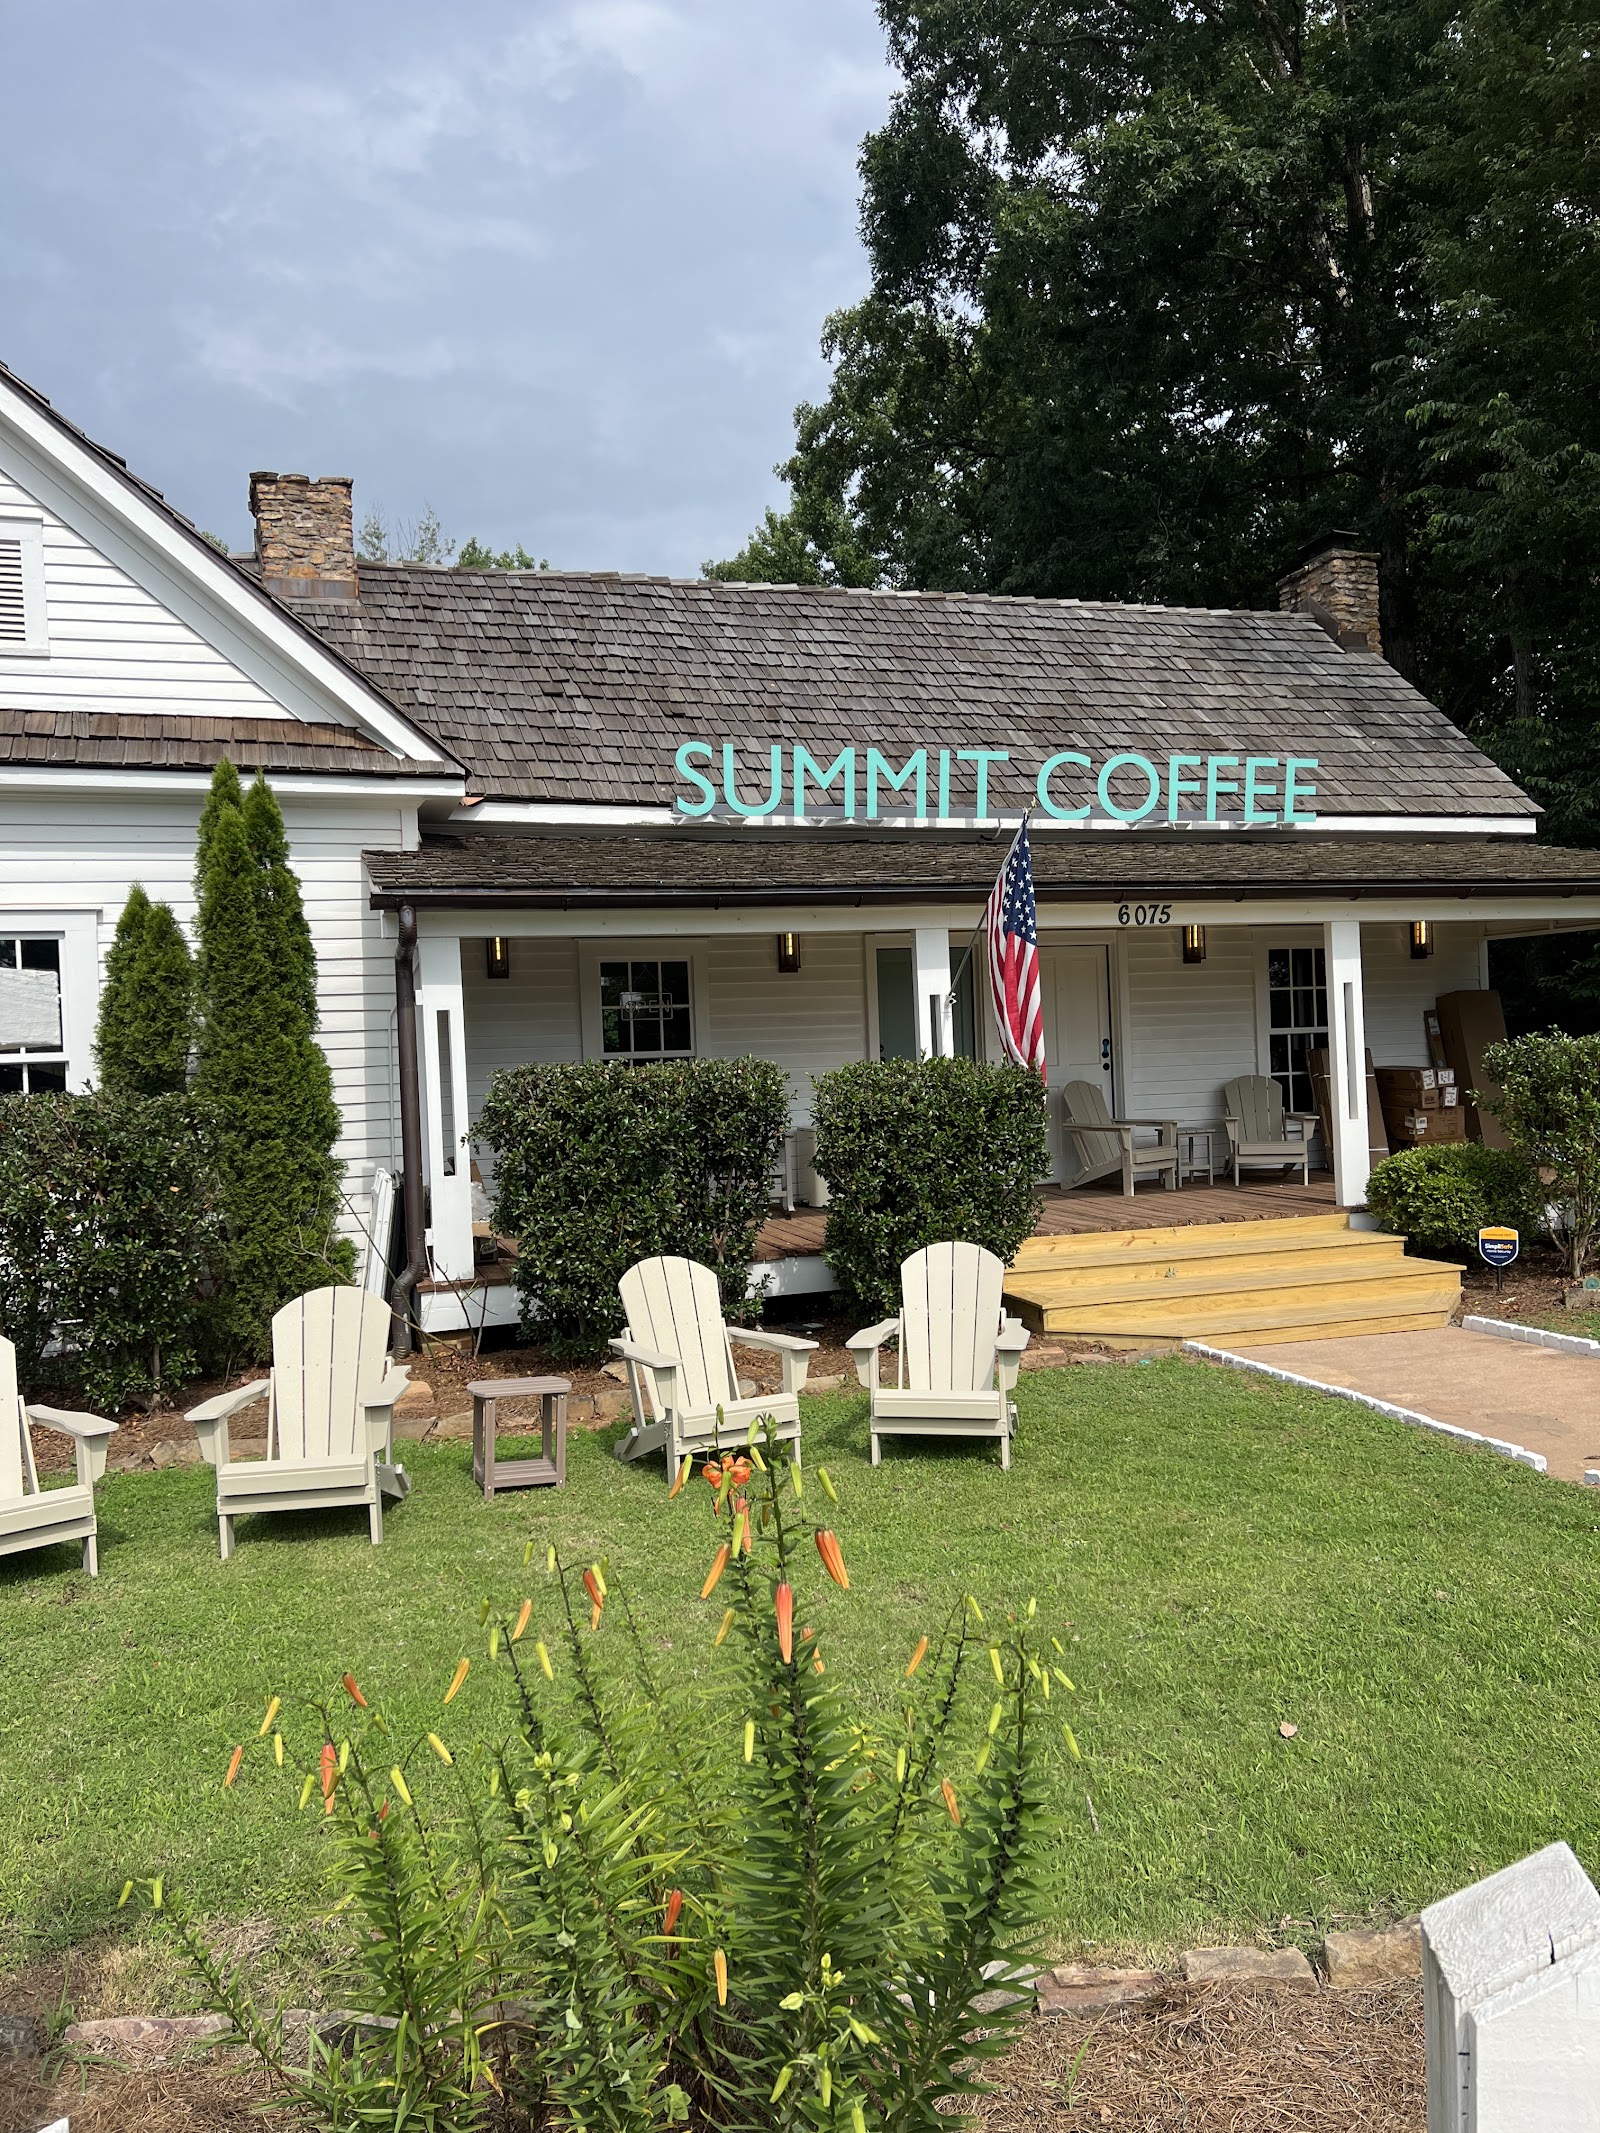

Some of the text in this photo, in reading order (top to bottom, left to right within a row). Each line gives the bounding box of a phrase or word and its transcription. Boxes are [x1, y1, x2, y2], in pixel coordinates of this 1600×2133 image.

[675, 741, 1319, 822] SUMMIT COFFEE
[1118, 904, 1172, 925] 6075
[625, 1000, 670, 1012] OPEN
